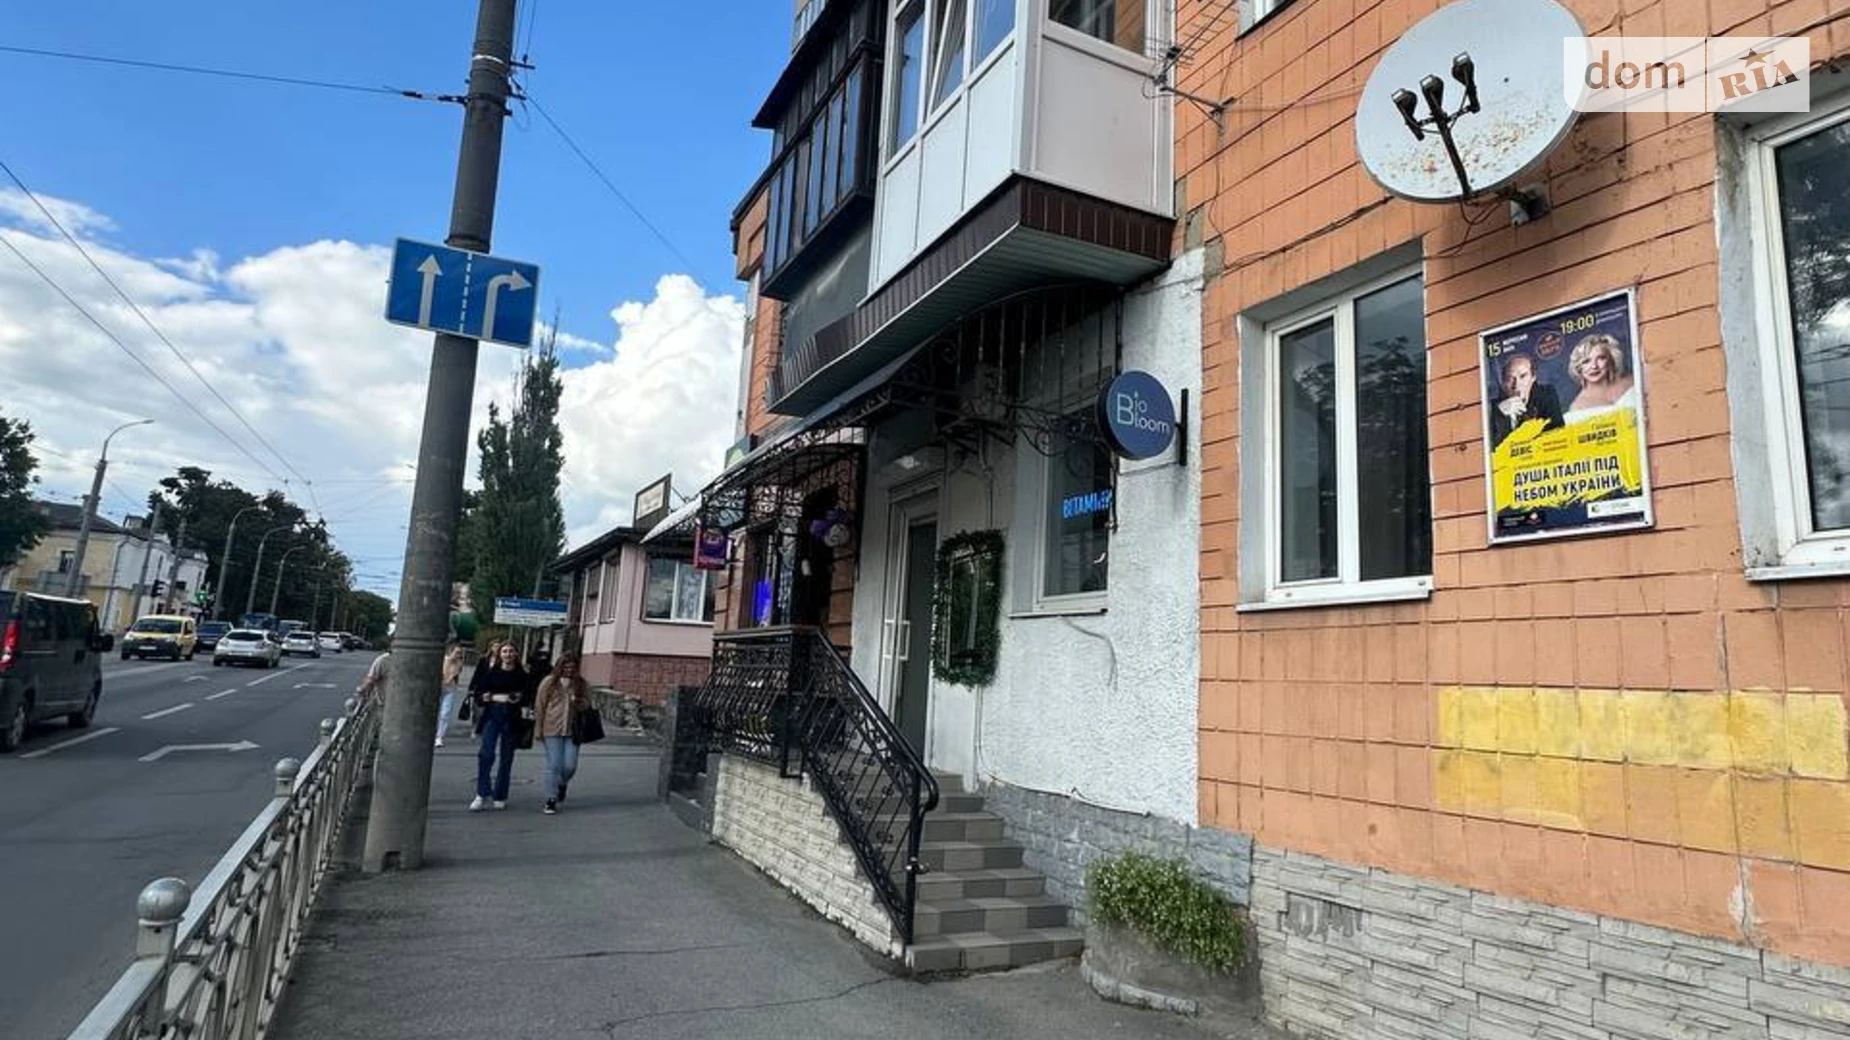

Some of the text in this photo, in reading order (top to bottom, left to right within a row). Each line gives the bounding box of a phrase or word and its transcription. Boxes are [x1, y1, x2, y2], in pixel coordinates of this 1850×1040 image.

[1560, 314, 1594, 334] 19:00
[1488, 342, 1501, 357] 15
[1578, 429, 1617, 444] ШВИДКІВ
[1510, 445, 1532, 458] ДЕВІС
[1513, 468, 1550, 487] ДУША
[1553, 459, 1591, 479] ІТАЛІЇ
[1595, 456, 1620, 471] ПІД
[1514, 473, 1621, 502] НЕБОМ УКРАЇНИ
